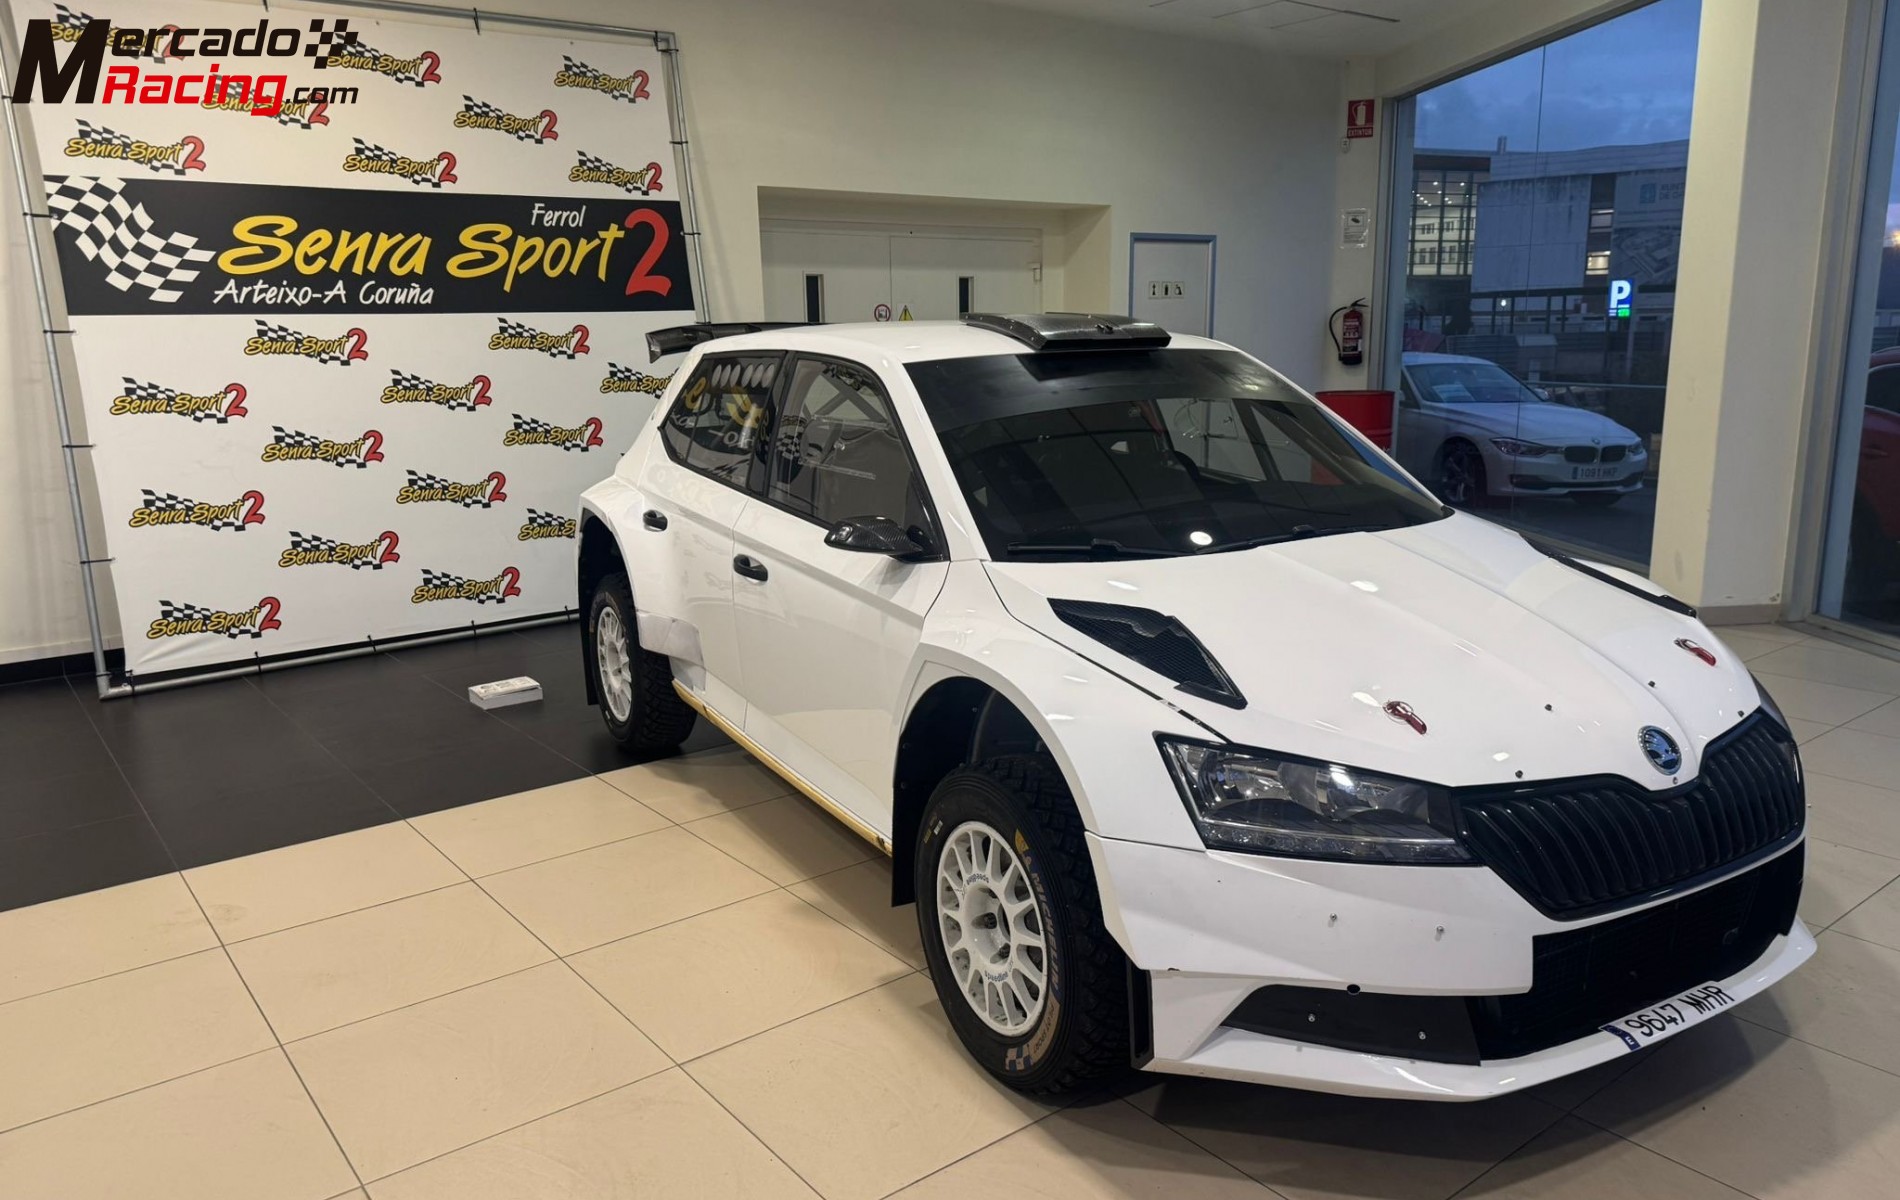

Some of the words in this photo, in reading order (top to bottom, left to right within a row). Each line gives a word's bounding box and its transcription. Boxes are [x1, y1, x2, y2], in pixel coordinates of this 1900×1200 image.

[377, 54, 422, 77] Sport
[421, 51, 441, 84] 2
[554, 70, 595, 89] Senra
[598, 73, 636, 95] Sport
[633, 70, 649, 100] 2
[454, 112, 497, 129] Senra
[501, 114, 544, 135] Sport
[540, 110, 559, 141] 2
[64, 137, 123, 158] Senra
[127, 139, 184, 165] Sport
[182, 136, 206, 171] 2
[343, 156, 390, 174] Senra
[395, 157, 441, 178] Sport
[438, 152, 458, 184] 2
[568, 167, 606, 185] Senra
[611, 169, 649, 189] Sport
[646, 162, 663, 192] 2
[531, 203, 587, 228] Ferrol
[217, 215, 432, 275] Senra
[446, 223, 625, 293] Sport
[624, 208, 672, 296] 2
[213, 280, 346, 307] Arteixo-A
[359, 281, 434, 305] Coruña
[1610, 280, 1631, 313] P
[244, 337, 297, 355] Senra
[299, 335, 348, 357] Sport
[347, 327, 368, 361] 2
[489, 333, 532, 350] Senra
[534, 332, 573, 352] Sport
[572, 324, 590, 354] 2
[110, 396, 167, 415] Senra
[170, 392, 226, 416] Sport
[224, 382, 248, 418] 2
[380, 386, 427, 403] Senra
[430, 382, 474, 403] Sport
[472, 375, 492, 406] 2
[600, 377, 638, 393] Senra
[641, 375, 672, 392] Spor
[261, 443, 312, 462] Senra
[316, 438, 365, 462] Sport
[362, 429, 384, 463] 2
[503, 429, 546, 446] Senra
[548, 425, 588, 445] Sport
[585, 416, 603, 447] 2
[396, 486, 443, 504] Senra
[446, 479, 490, 500] Sport
[487, 471, 507, 502] 2
[129, 508, 186, 528] Senra
[190, 499, 244, 524] Sport
[241, 490, 265, 525] 2
[279, 549, 329, 567] Senra
[334, 539, 381, 562] Sport
[379, 530, 400, 564] 2
[518, 523, 560, 541] Senra
[411, 585, 458, 604] Senra
[460, 575, 504, 597] Sport
[501, 566, 521, 597] 2
[147, 618, 202, 639] Senra
[207, 606, 261, 632] Sport
[259, 596, 281, 631] 2
[1031, 872, 1059, 990] MICHELIN
[1624, 1003, 1686, 1037] 9647
[1677, 985, 1735, 1015] MHR
